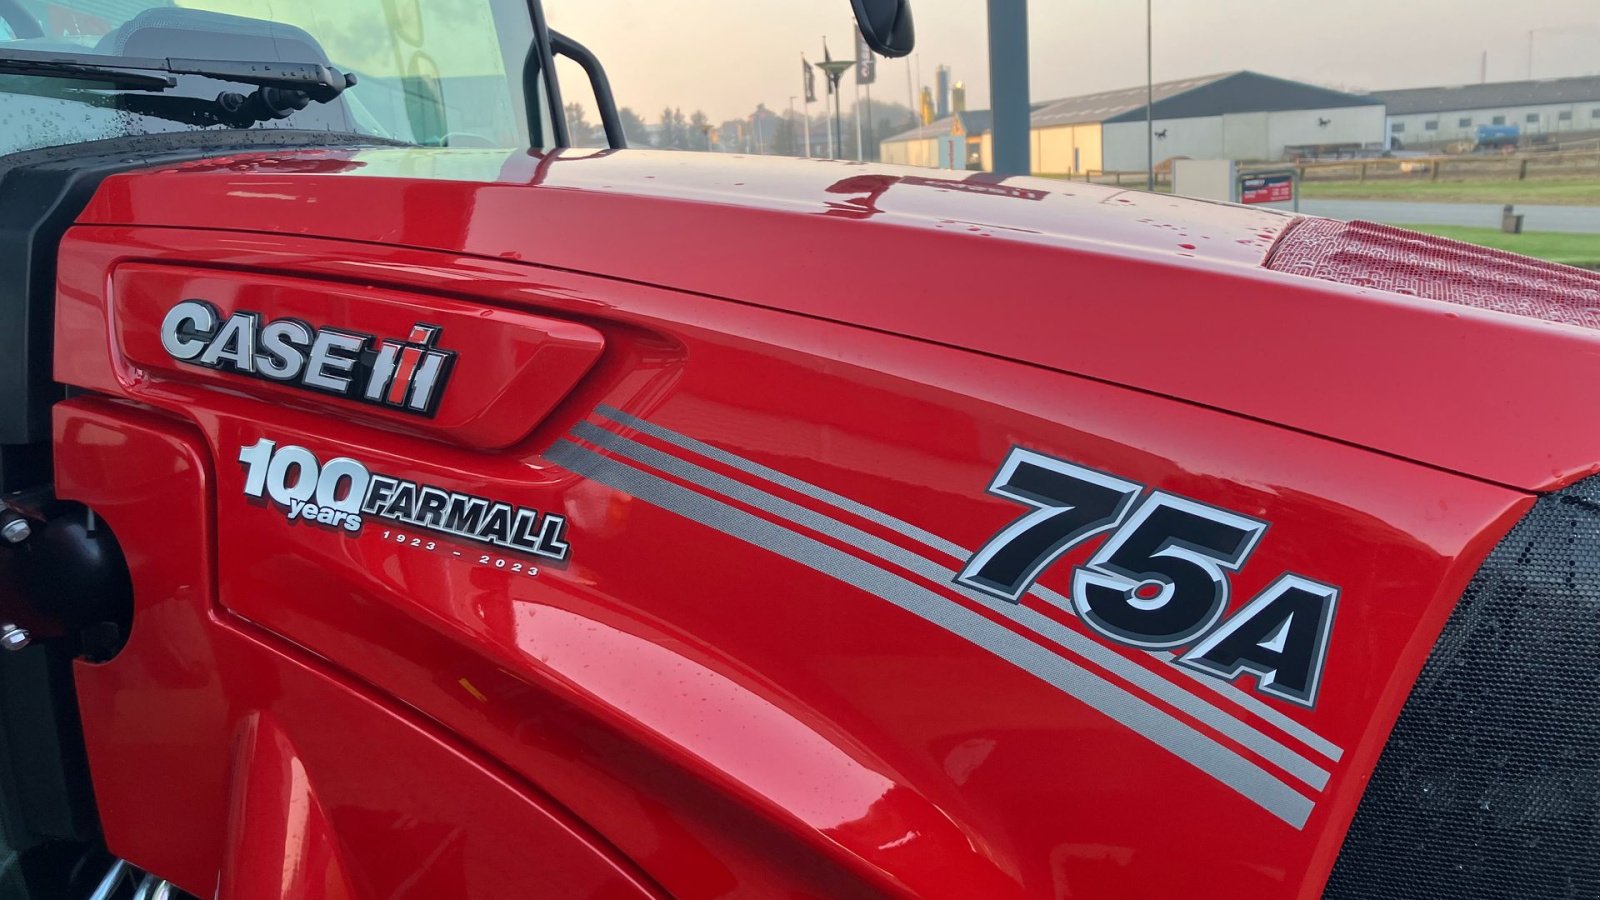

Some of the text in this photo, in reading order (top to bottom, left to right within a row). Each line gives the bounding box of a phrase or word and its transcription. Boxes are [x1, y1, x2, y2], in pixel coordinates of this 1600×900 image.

[161, 300, 369, 393] CASE
[239, 438, 370, 512] 100
[287, 497, 362, 532] years
[363, 474, 569, 561] FARMALL
[383, 530, 436, 550] 1923
[479, 555, 539, 576] 2023
